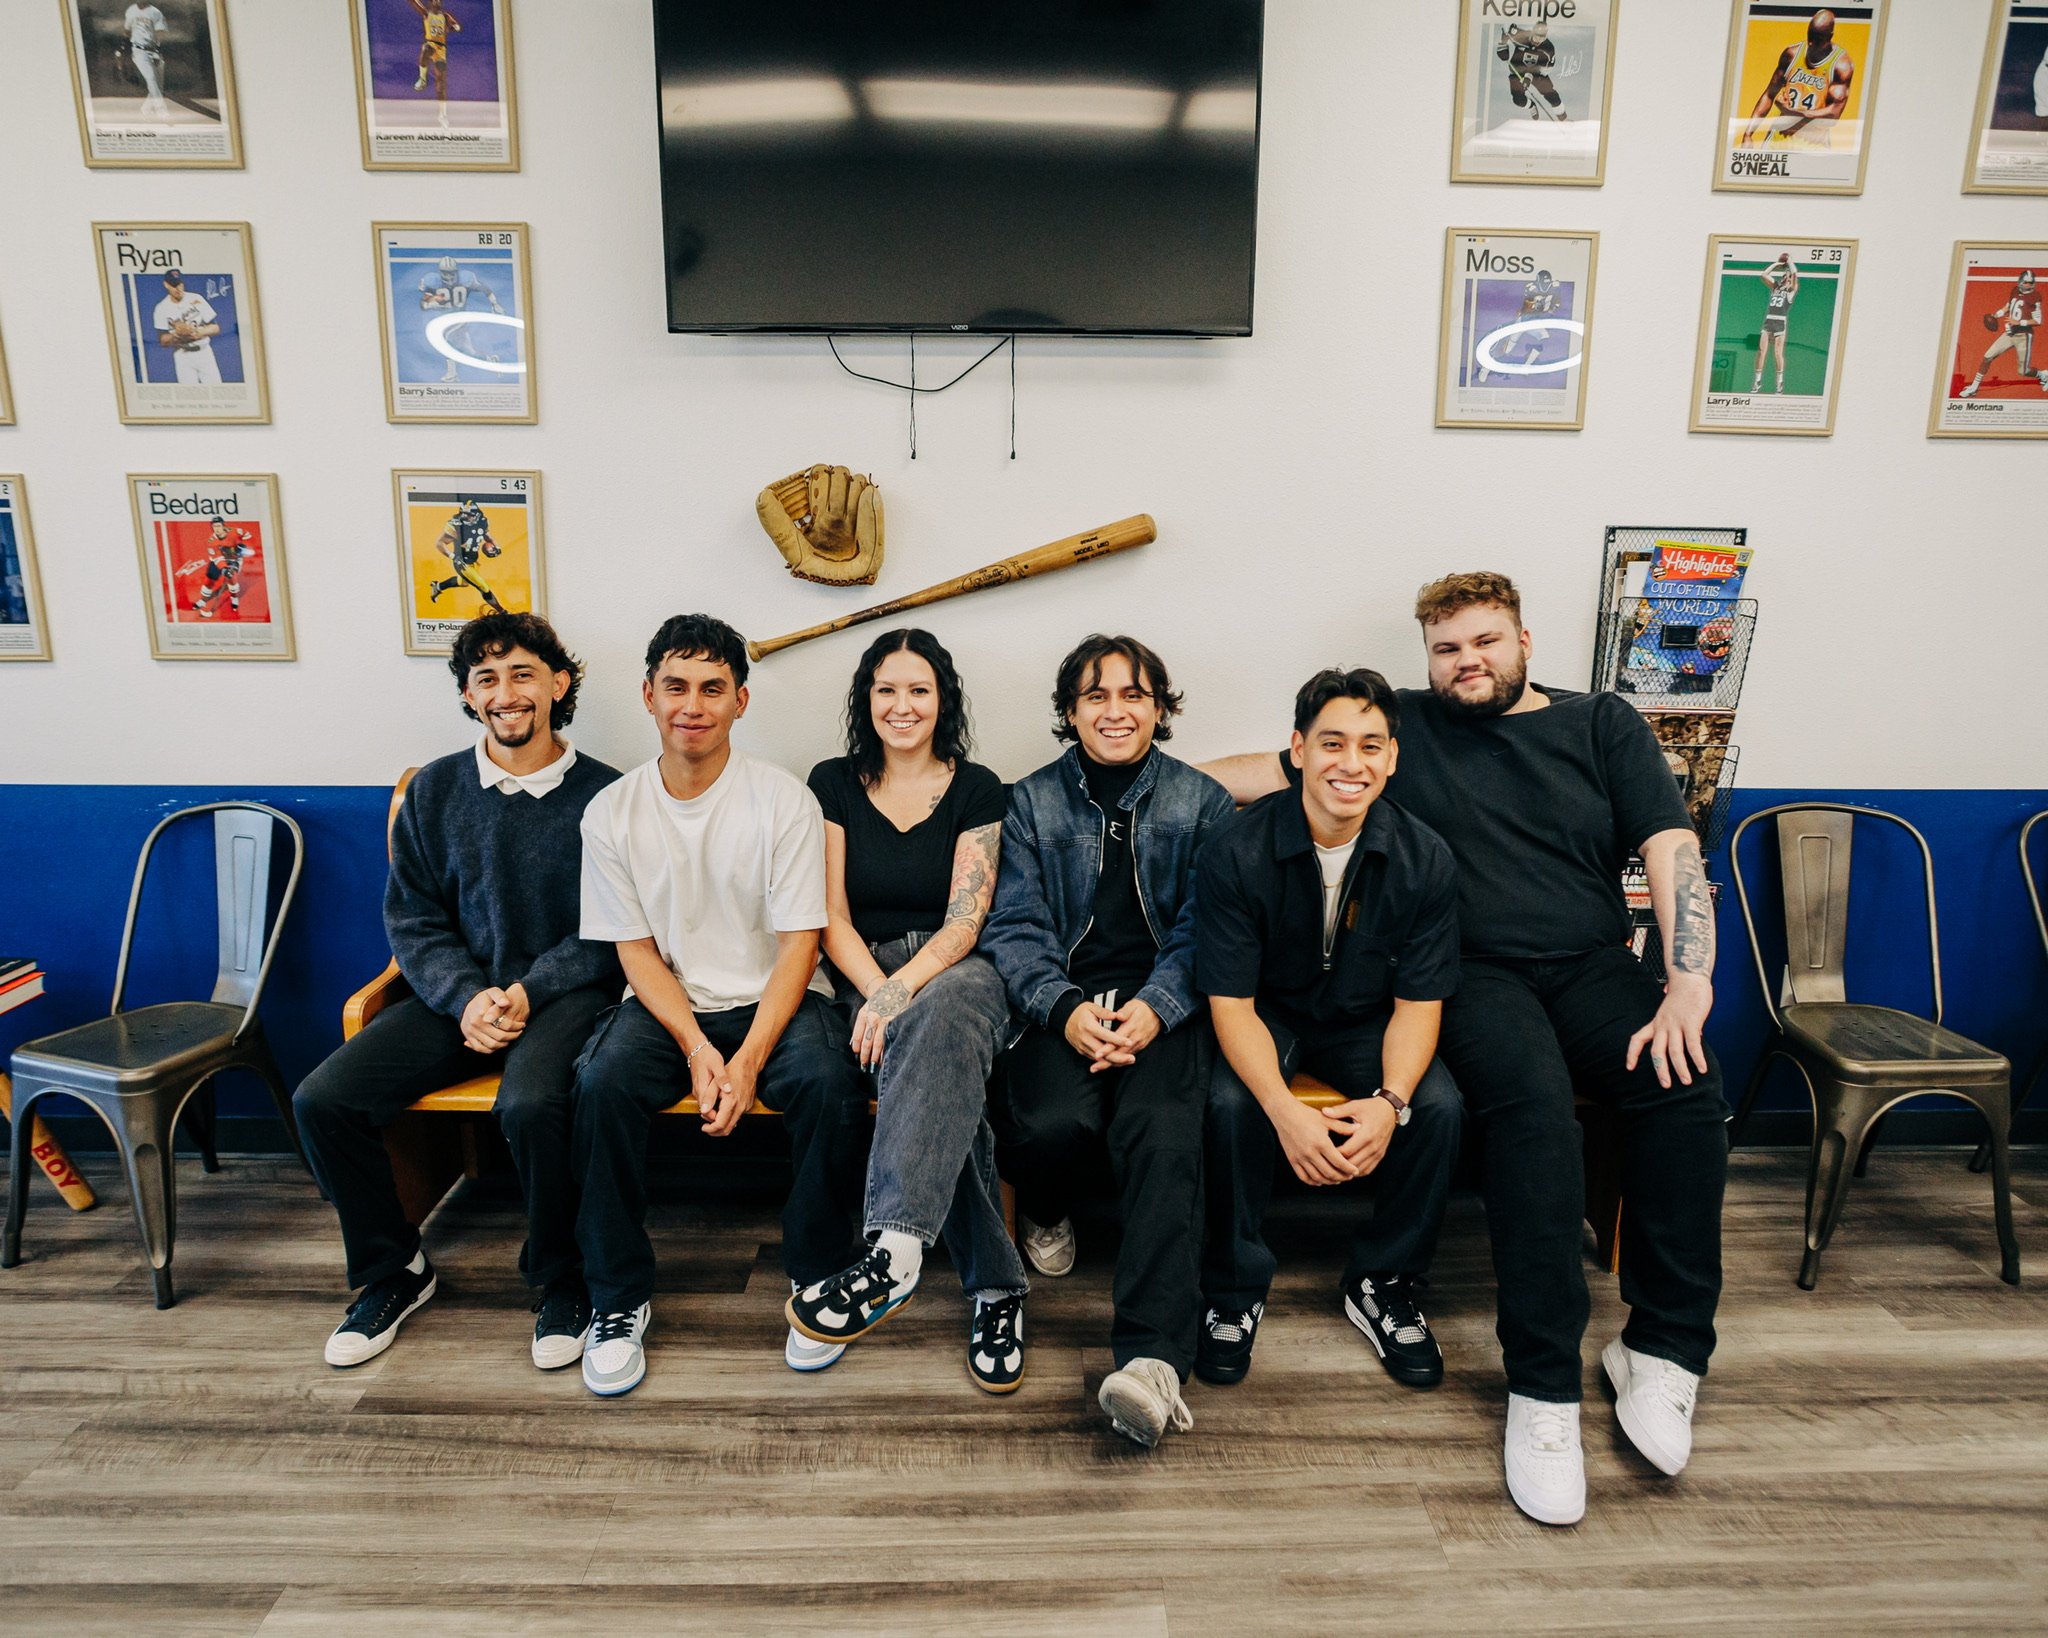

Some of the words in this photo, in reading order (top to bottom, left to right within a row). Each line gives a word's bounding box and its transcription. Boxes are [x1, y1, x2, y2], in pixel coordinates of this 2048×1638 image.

[1482, 0, 1577, 21] Kempe
[1789, 68, 1825, 90] LAKERS
[1788, 88, 1815, 110] 34
[1732, 152, 1788, 163] SHAQUILLE
[1731, 162, 1790, 177] O'NEAL
[478, 233, 493, 245] RB
[499, 233, 512, 245] 20
[117, 243, 184, 273] Ryan
[1465, 248, 1535, 274] Moss
[1811, 249, 1824, 260] SF
[1829, 250, 1842, 261] 33
[1769, 296, 1784, 308] 33
[2010, 298, 2024, 321] 16
[399, 387, 424, 397] Barry
[426, 387, 465, 396] Sanders
[1707, 397, 1731, 407] Larry
[1732, 398, 1750, 406] Bird
[1947, 402, 1963, 411] Joe
[1965, 402, 2004, 412] Montana
[514, 480, 526, 490] 43
[150, 492, 239, 515] Bedard
[1663, 550, 1735, 576] Highlights
[1651, 581, 1676, 594] OUT
[1676, 583, 1694, 595] OF
[1695, 585, 1721, 597] THIS
[416, 622, 437, 632] Troy
[32, 1141, 81, 1188] BOY
